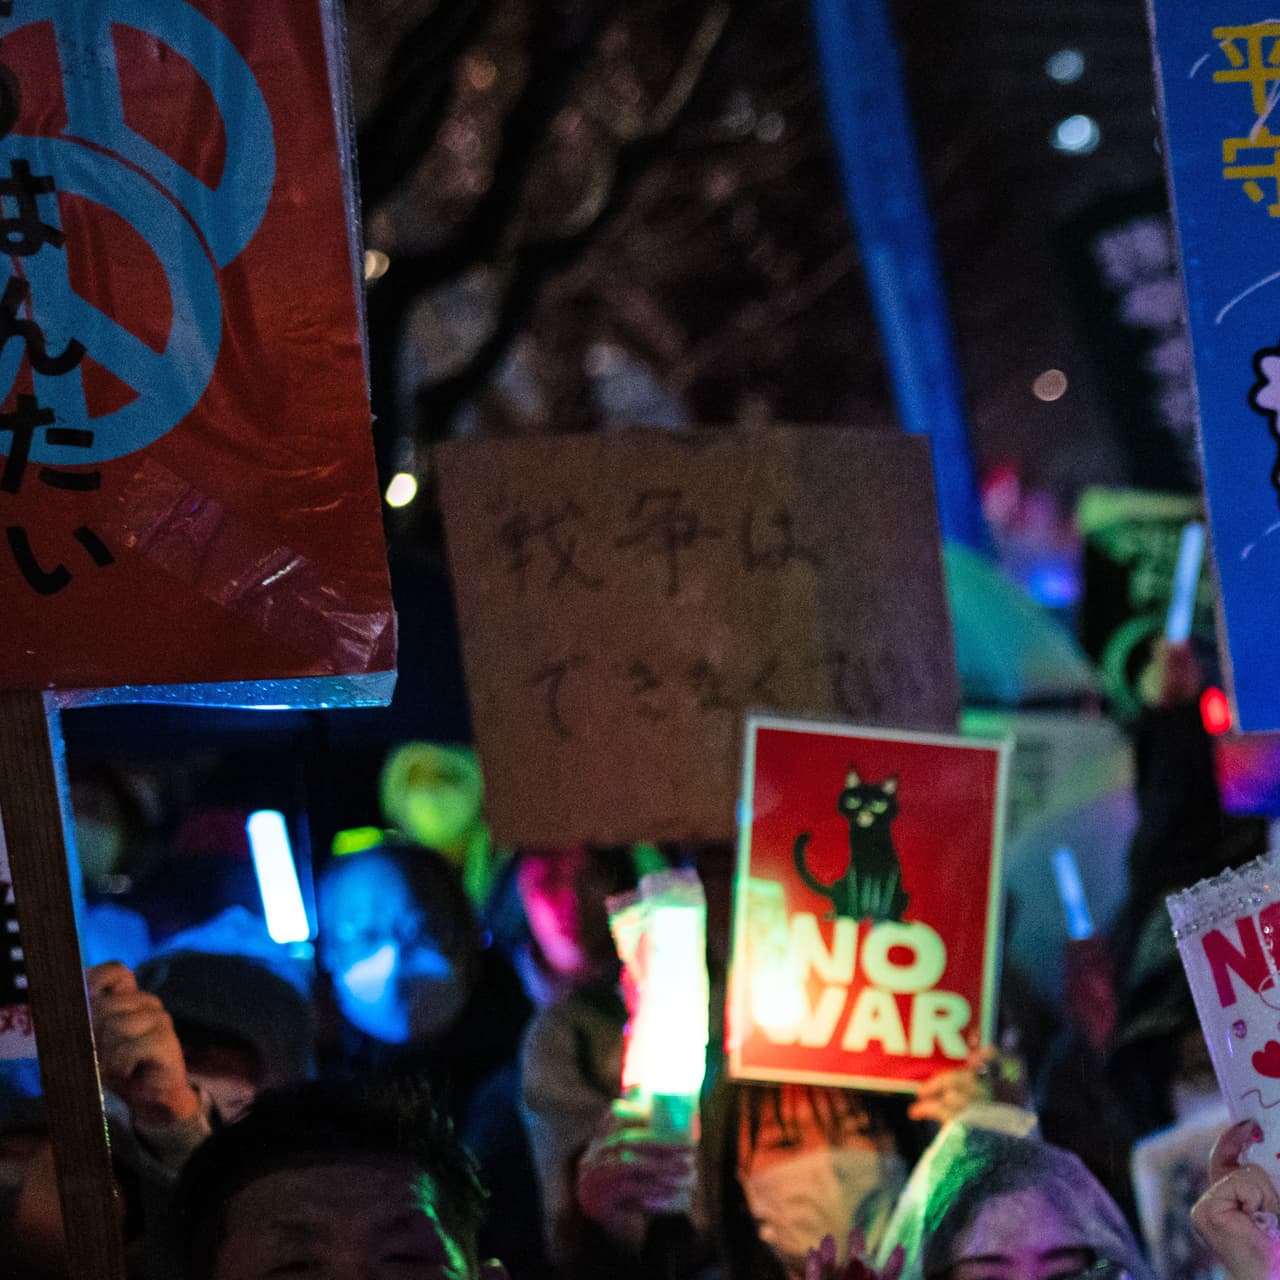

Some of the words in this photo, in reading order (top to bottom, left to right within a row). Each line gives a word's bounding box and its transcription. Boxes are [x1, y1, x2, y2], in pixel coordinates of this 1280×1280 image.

[0, 62, 116, 596] はんたい
[788, 911, 947, 994] NO
[752, 984, 971, 1059] WAR
